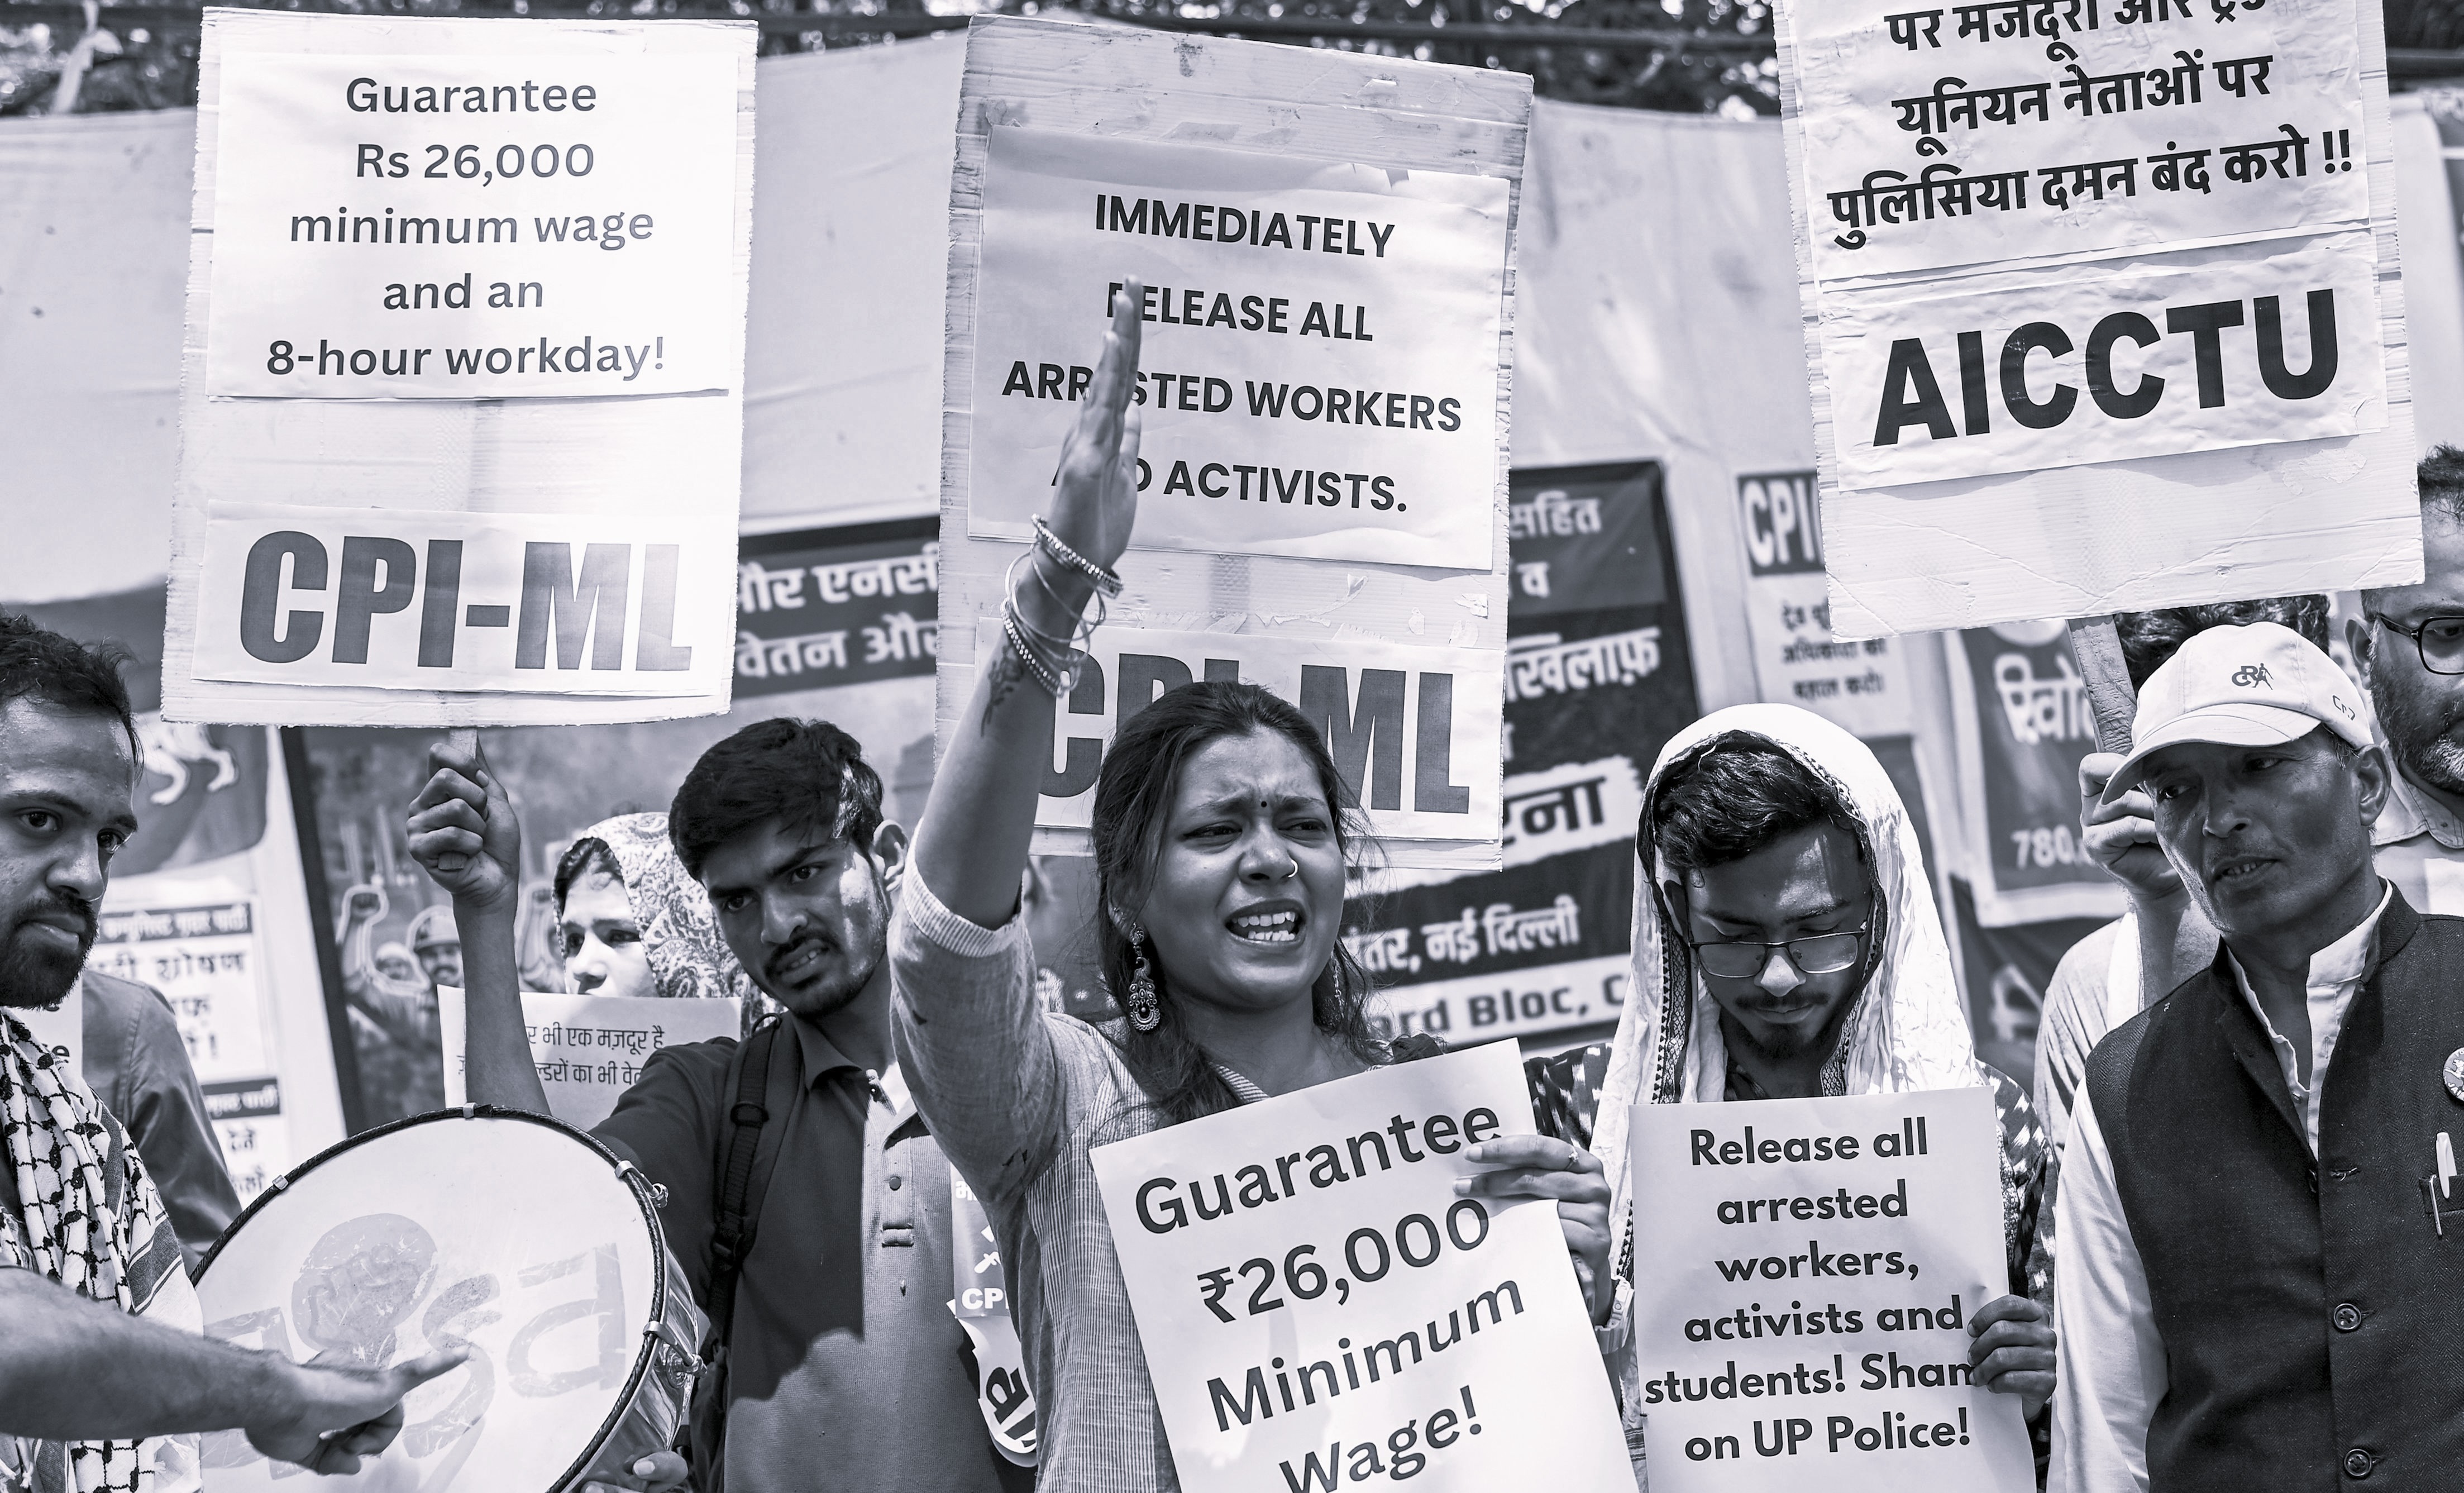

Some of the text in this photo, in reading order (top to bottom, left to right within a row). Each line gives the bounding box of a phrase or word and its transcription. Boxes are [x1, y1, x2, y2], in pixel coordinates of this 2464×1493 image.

[1884, 9, 1943, 50] पर
[347, 78, 596, 112] Guarantee
[1892, 49, 2273, 156] यूनियन नेताओं पर
[357, 144, 593, 187] Rs 26,000
[1827, 164, 2029, 250] पुलिसिया
[2037, 158, 2138, 211] दमन
[2147, 141, 2211, 194] बंद
[2219, 124, 2309, 183] करो
[292, 207, 653, 250] minimum wage
[1096, 194, 1395, 257] IMMEDIATELY
[384, 273, 542, 309] and an
[1300, 302, 1372, 341] ALL
[268, 336, 662, 381] 8-hour workday!
[1873, 288, 2339, 447] AICCTU
[1001, 361, 1460, 431] ARRSTED WORKERS
[1163, 460, 1406, 512] ACTIVISTS.
[240, 531, 689, 671] CPI-ML
[542, 1022, 562, 1046] भी
[566, 1028, 593, 1047] एक
[572, 1064, 593, 1083] का
[598, 1061, 617, 1085] भी
[1691, 1117, 1927, 1165] Release all
[1135, 1107, 1501, 1234] Guarantee
[1717, 1179, 1907, 1224] arrested
[1197, 1198, 1489, 1324] ₹26,000
[1715, 1241, 1918, 1281] workers,
[1685, 1295, 1963, 1342] activists and
[1207, 1279, 1525, 1432] Minimum
[1645, 1354, 1845, 1404] students!
[1279, 1384, 1483, 1493] Wage!
[1685, 1407, 1970, 1461] on UP Police!
